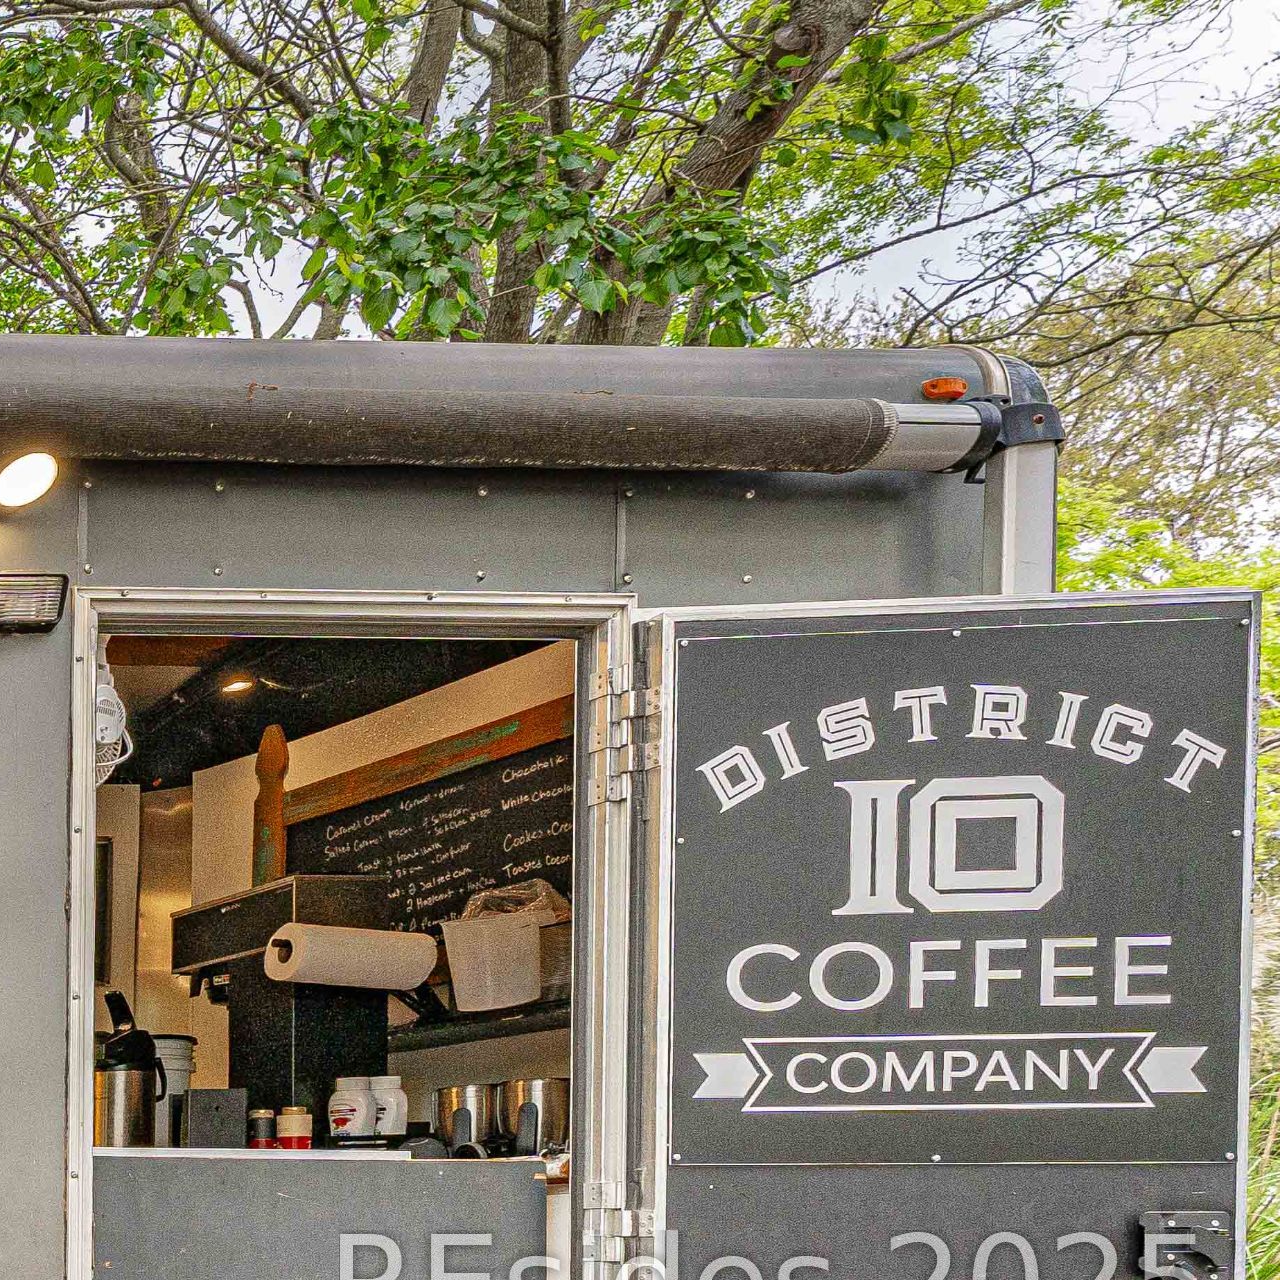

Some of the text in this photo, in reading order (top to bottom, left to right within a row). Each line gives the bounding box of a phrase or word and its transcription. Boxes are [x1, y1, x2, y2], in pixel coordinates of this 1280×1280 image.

[695, 684, 1227, 814] DISTRICT
[531, 784, 573, 803] Chocola
[831, 775, 1065, 916] 10
[726, 936, 1172, 1012] COFFEE
[785, 1047, 1115, 1094] COMPANY
